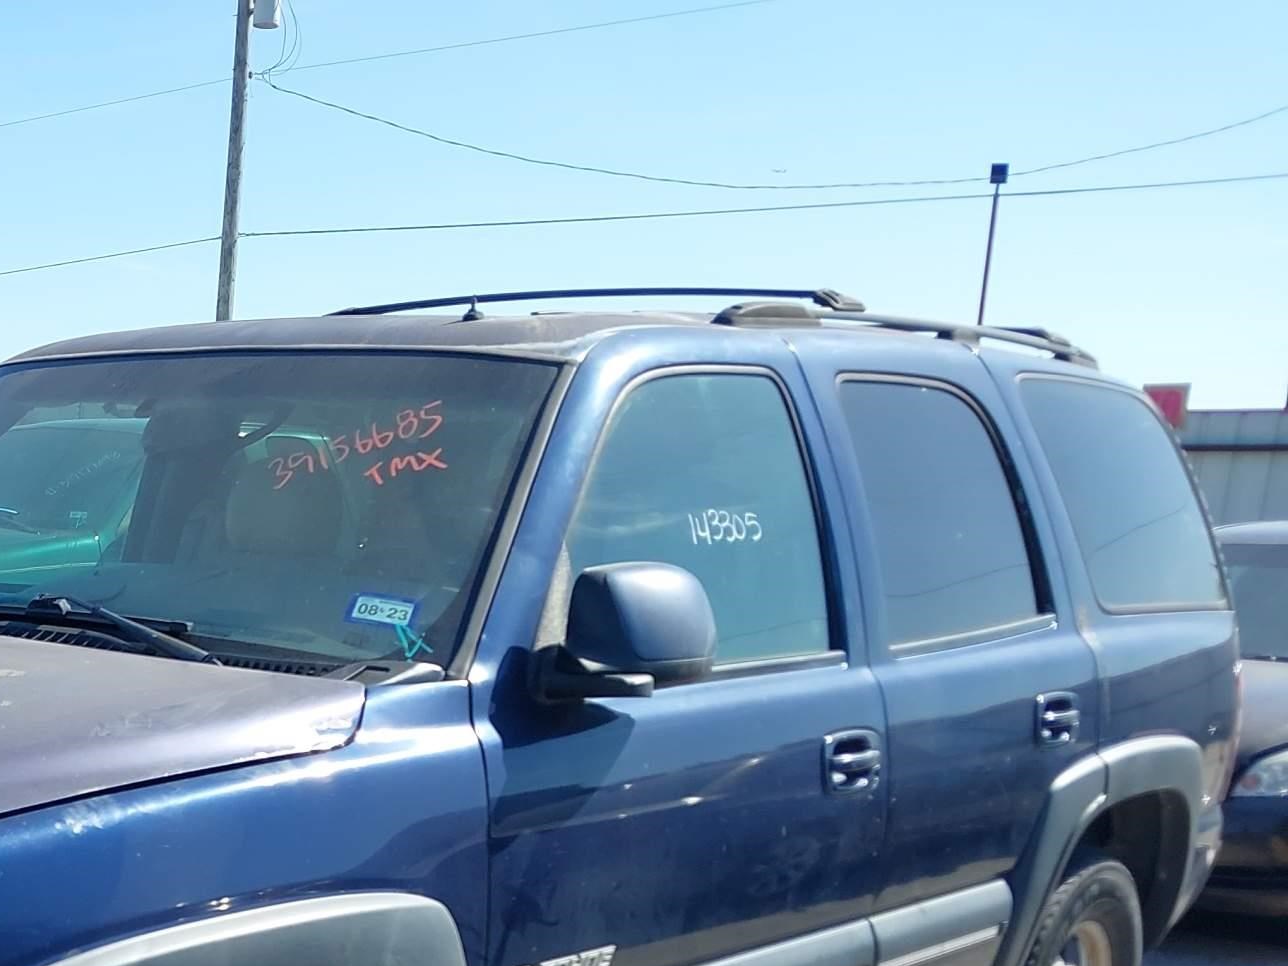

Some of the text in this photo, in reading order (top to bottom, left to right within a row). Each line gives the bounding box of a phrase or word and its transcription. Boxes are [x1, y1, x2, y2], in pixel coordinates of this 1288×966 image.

[267, 399, 443, 490] 39156685
[363, 447, 449, 486] TMX
[687, 508, 763, 545] 143305
